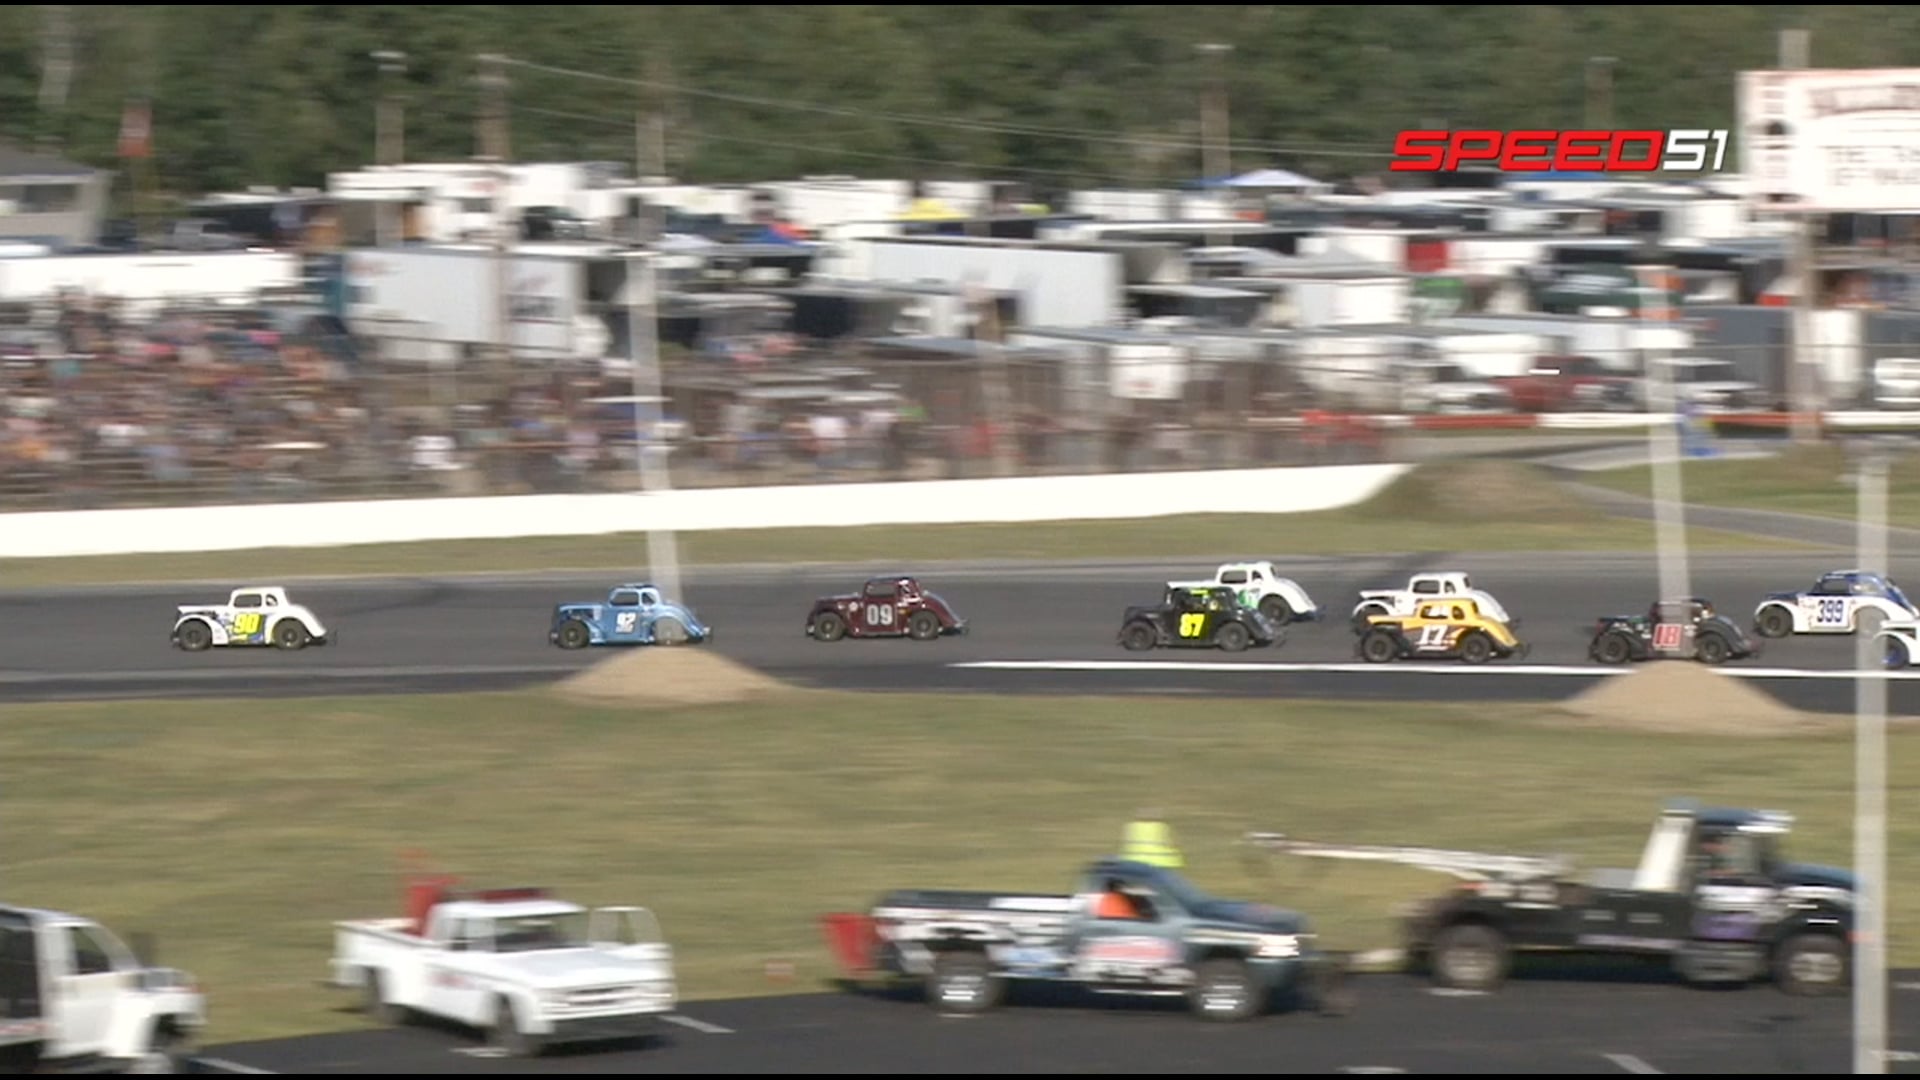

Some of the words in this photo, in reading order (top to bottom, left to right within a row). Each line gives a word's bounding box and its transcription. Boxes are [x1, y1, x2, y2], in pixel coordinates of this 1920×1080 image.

[866, 604, 893, 626] 09
[1817, 599, 1844, 622] 399
[234, 613, 260, 633] 90
[1179, 613, 1205, 637] 87
